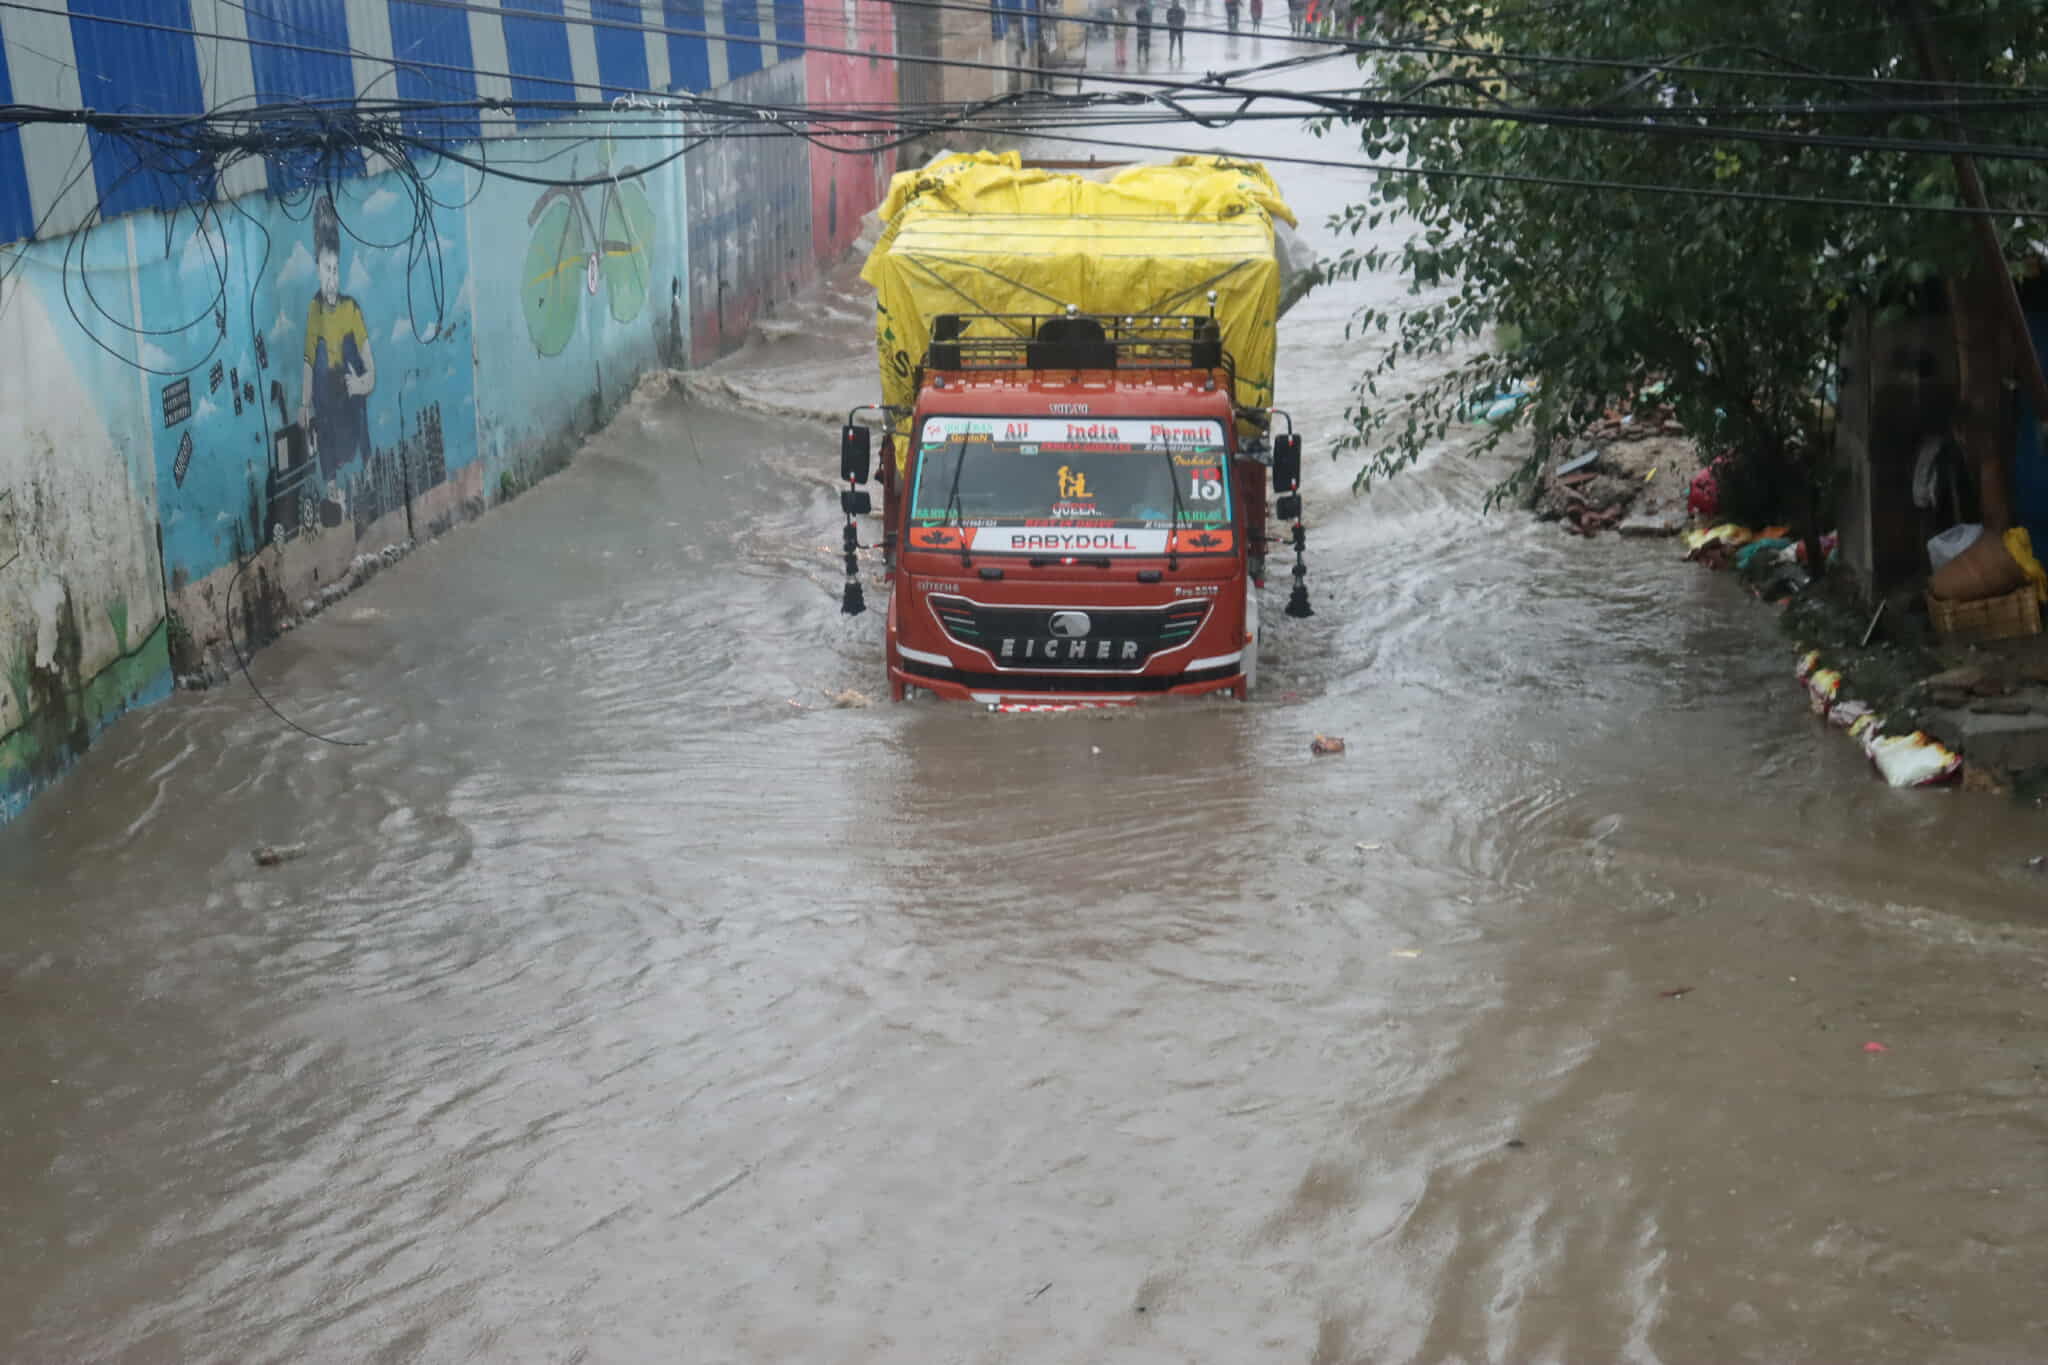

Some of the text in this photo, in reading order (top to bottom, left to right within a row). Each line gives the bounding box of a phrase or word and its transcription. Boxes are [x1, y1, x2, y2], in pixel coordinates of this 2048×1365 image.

[1005, 423, 1029, 440] All
[1065, 423, 1120, 441] India
[1149, 424, 1212, 443] Permit
[1000, 638, 1139, 659] EICHER
